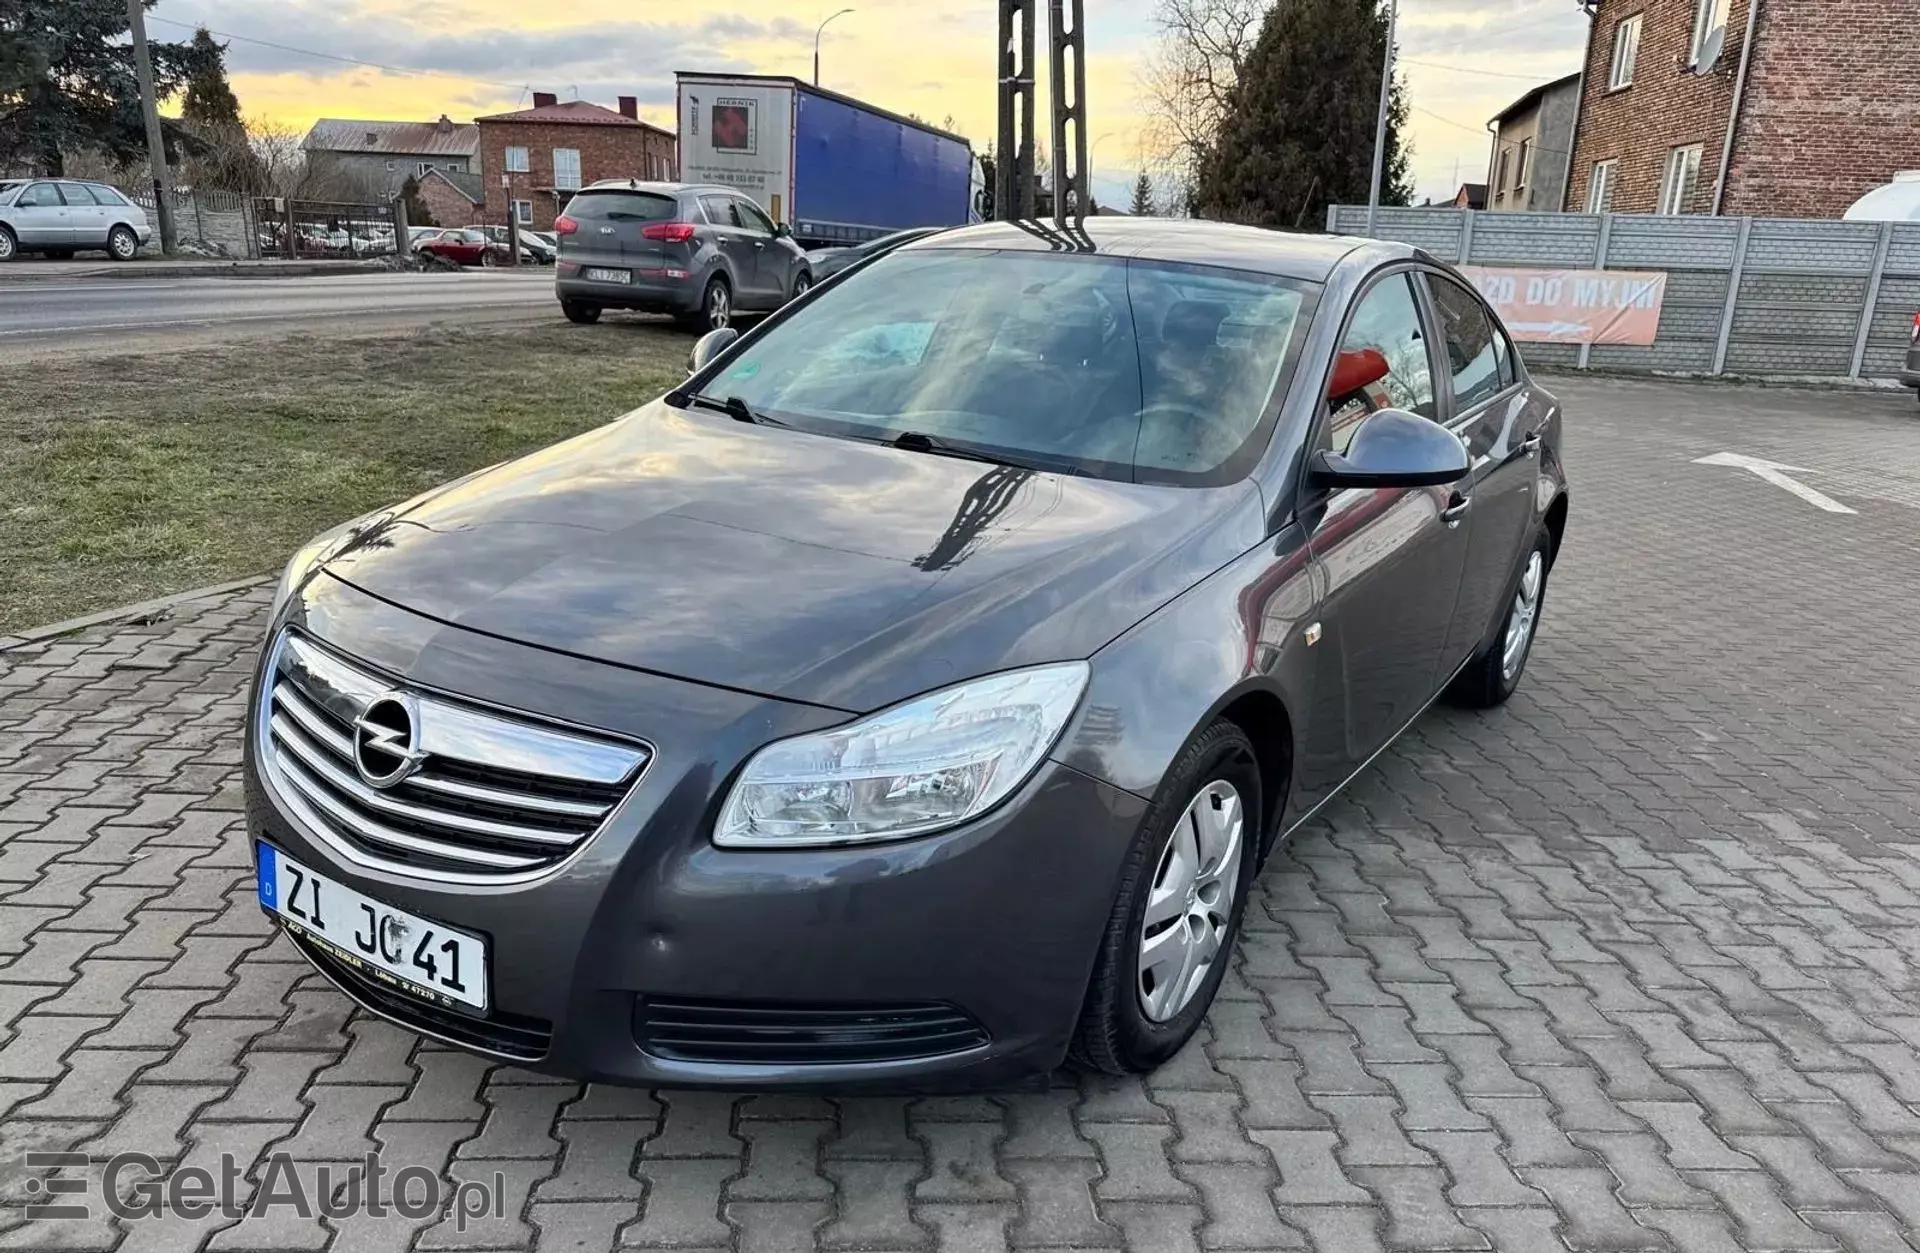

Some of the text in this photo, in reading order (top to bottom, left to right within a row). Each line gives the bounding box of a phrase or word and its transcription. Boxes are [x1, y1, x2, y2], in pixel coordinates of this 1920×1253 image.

[1525, 276, 1562, 306] DO
[265, 882, 273, 896] D
[285, 863, 325, 930] ZI
[412, 930, 466, 994] 41
